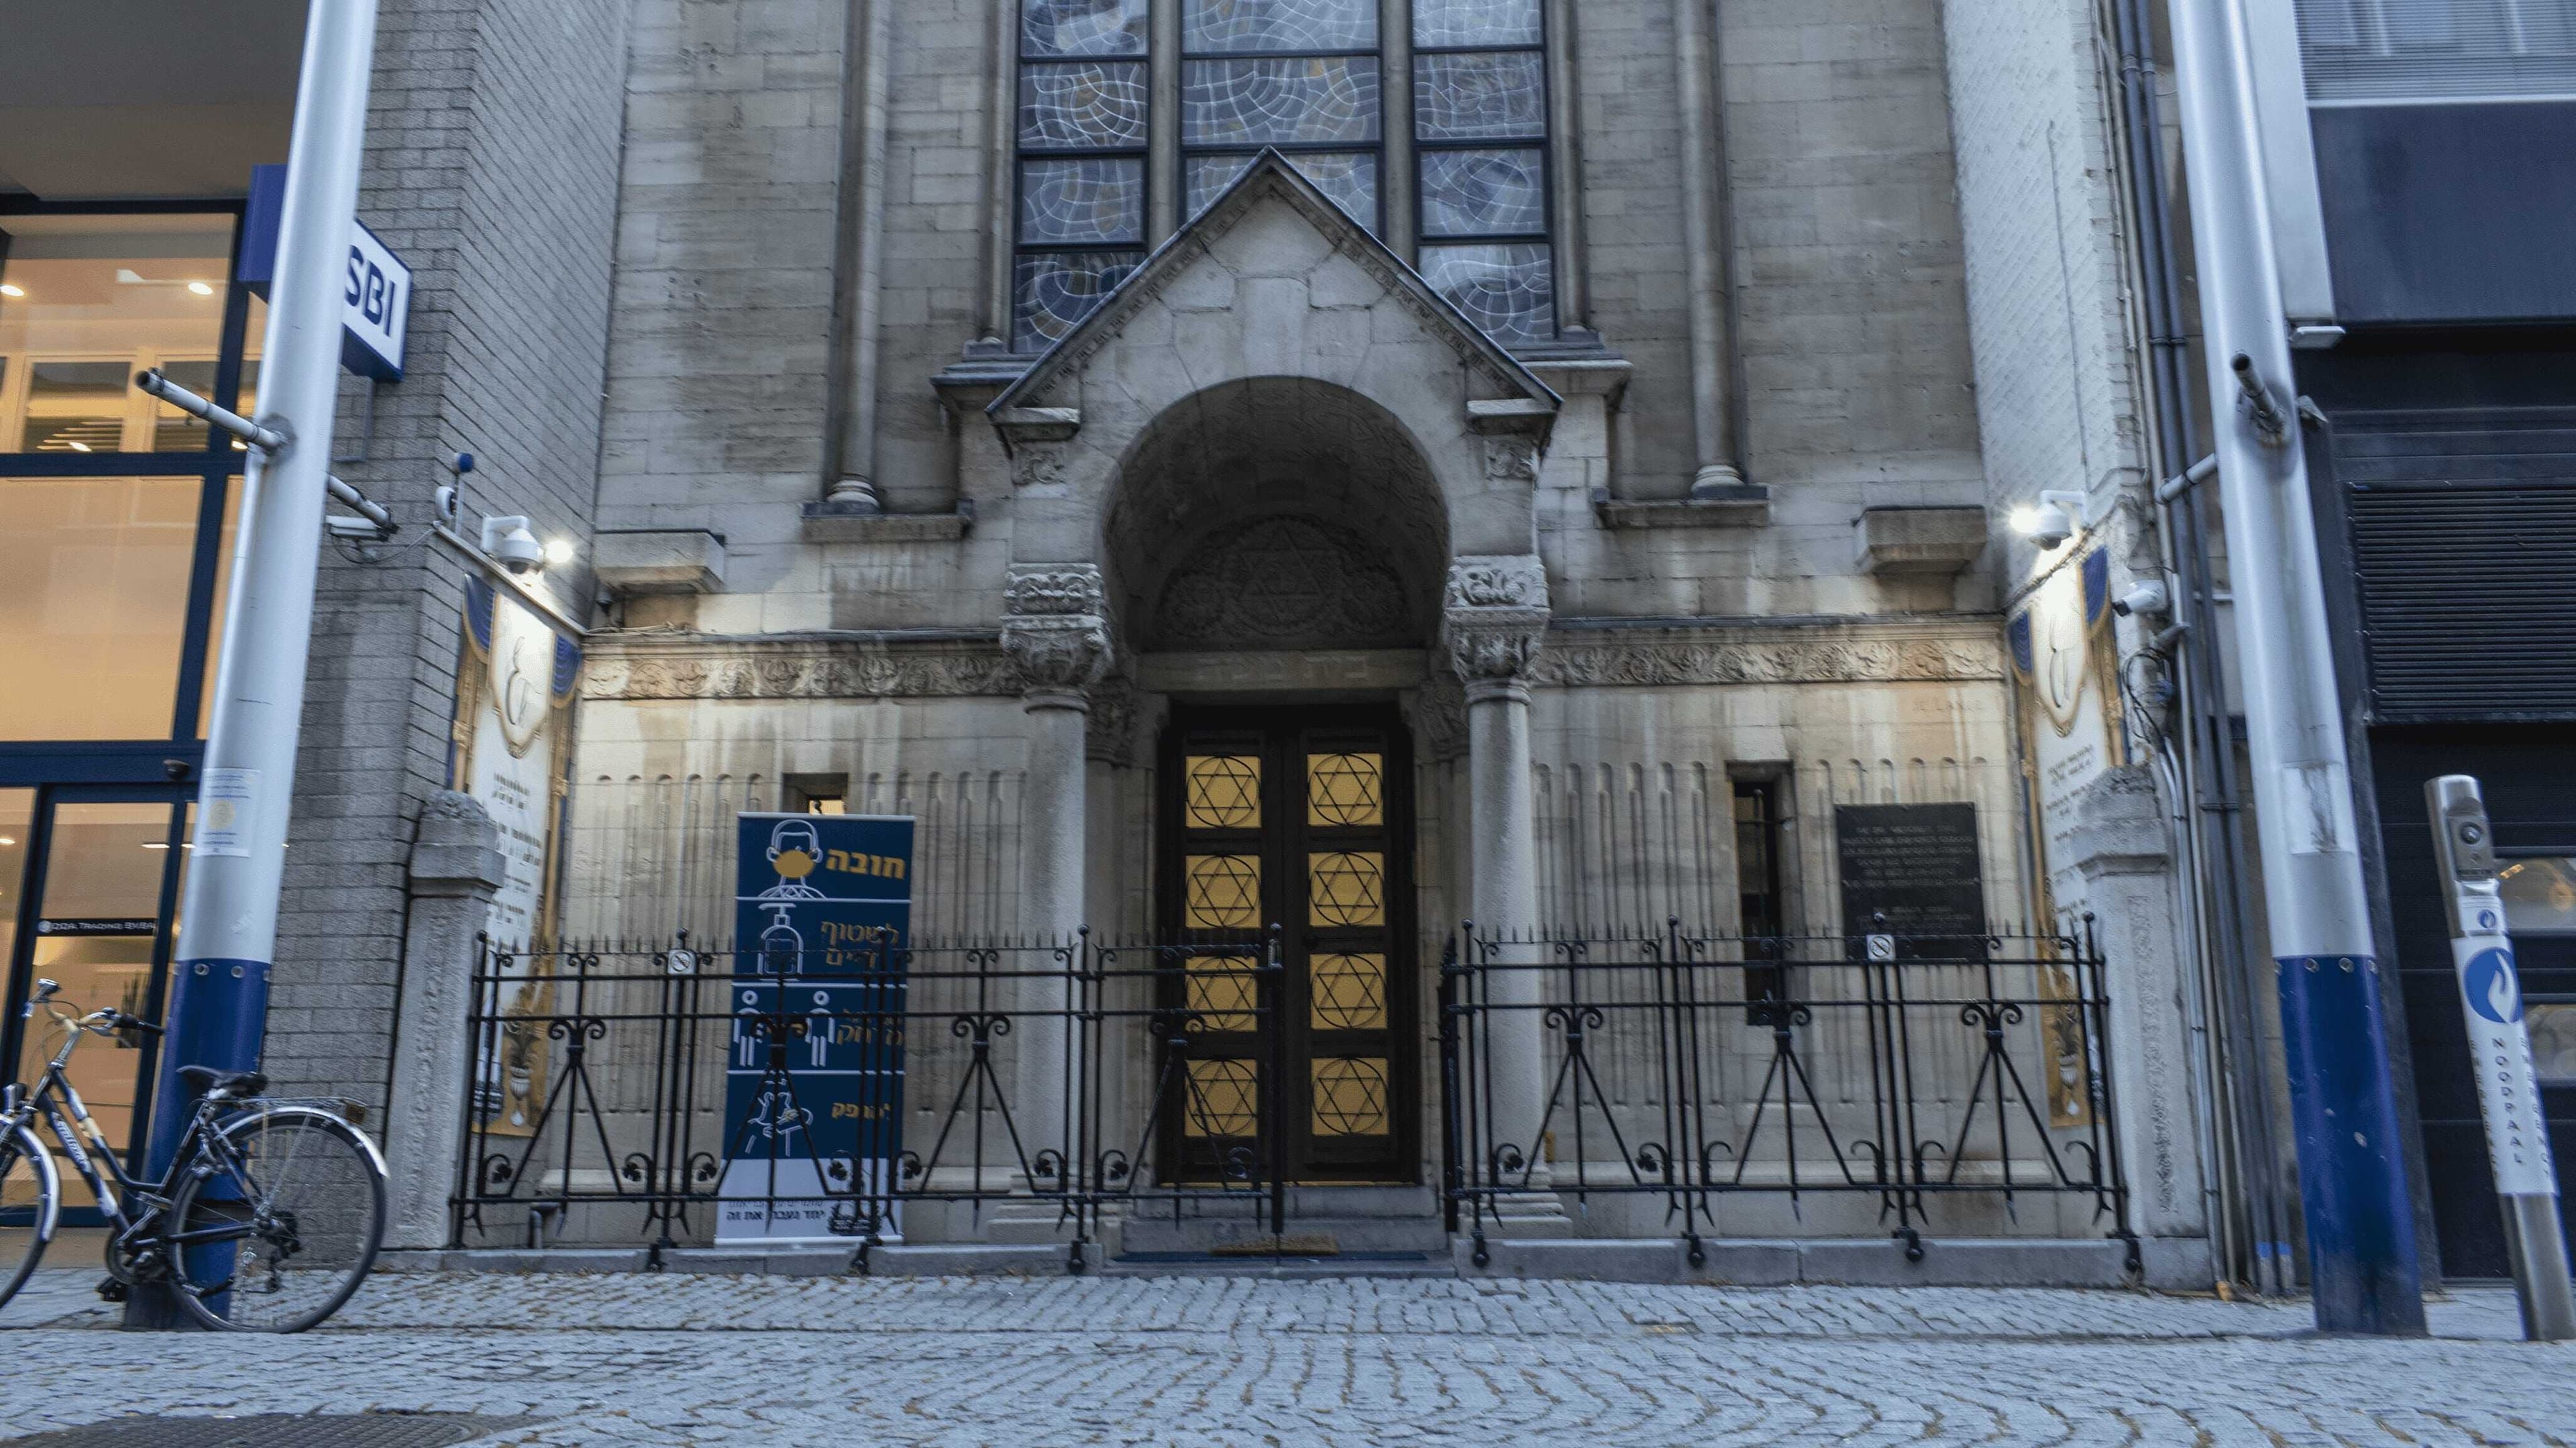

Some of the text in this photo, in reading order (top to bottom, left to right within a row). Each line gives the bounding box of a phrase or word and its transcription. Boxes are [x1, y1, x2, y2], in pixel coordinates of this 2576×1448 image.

[344, 245, 395, 337] SBI
[826, 848, 904, 880] חובה
[78, 922, 123, 930] TRADING
[2491, 1038, 2523, 1164] NOODPAAL
